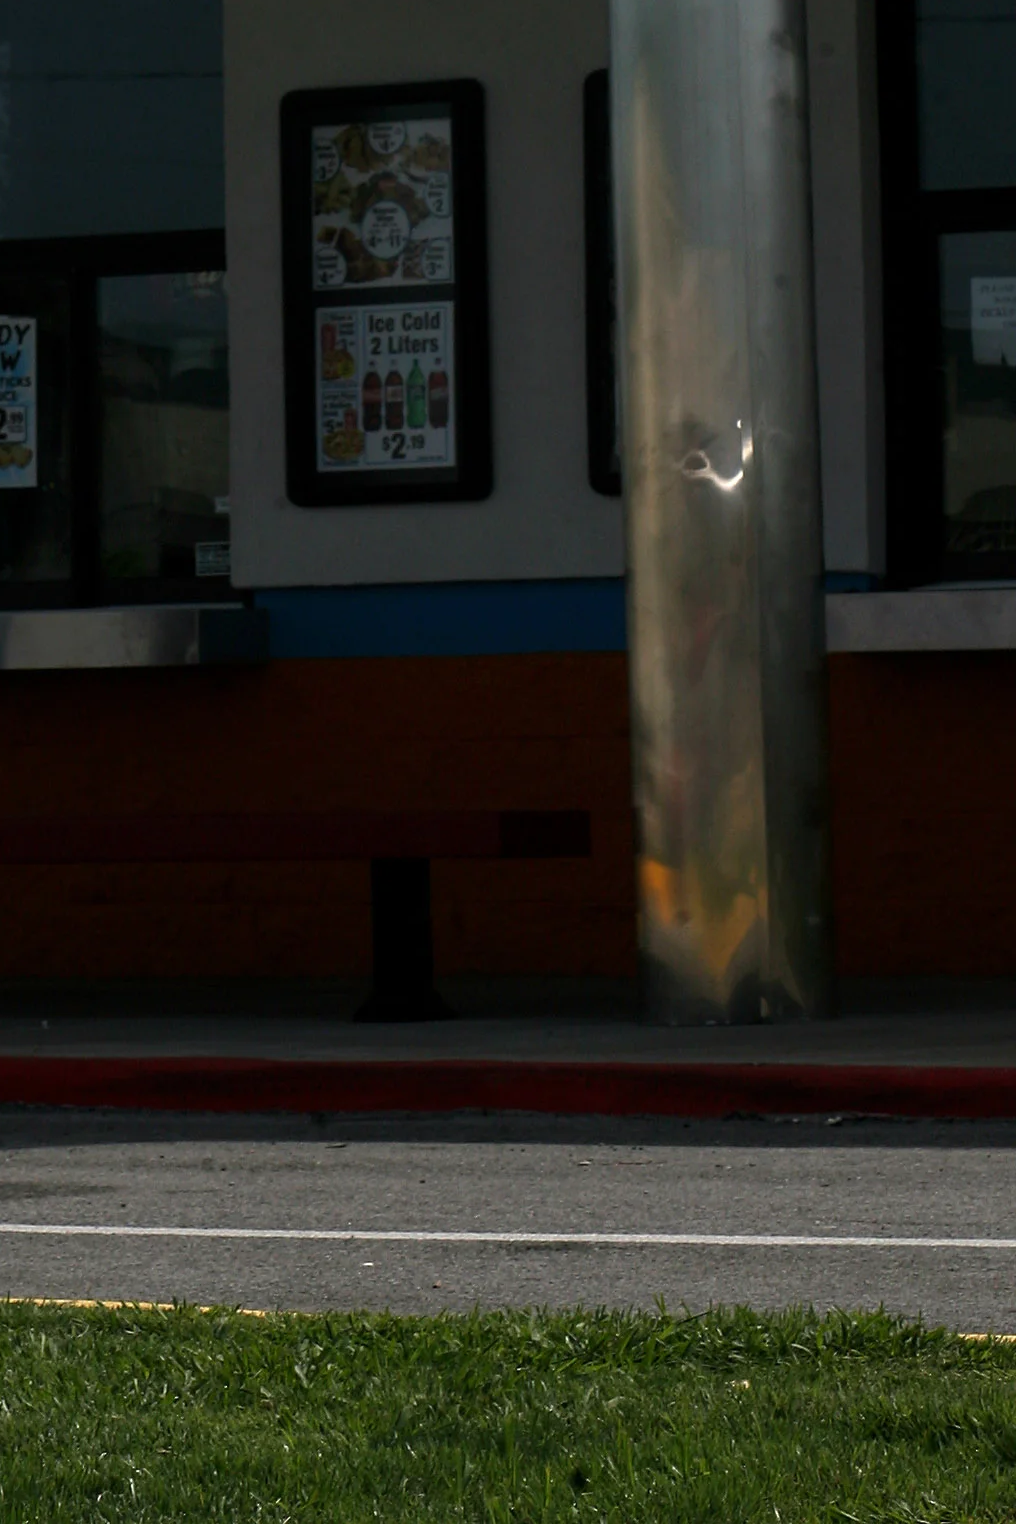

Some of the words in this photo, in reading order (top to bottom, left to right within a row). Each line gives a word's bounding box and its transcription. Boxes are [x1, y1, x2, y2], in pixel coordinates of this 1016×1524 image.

[368, 314, 395, 333] Ice
[402, 311, 441, 332] Cold
[370, 337, 382, 355] 2
[387, 335, 439, 355] Liters
